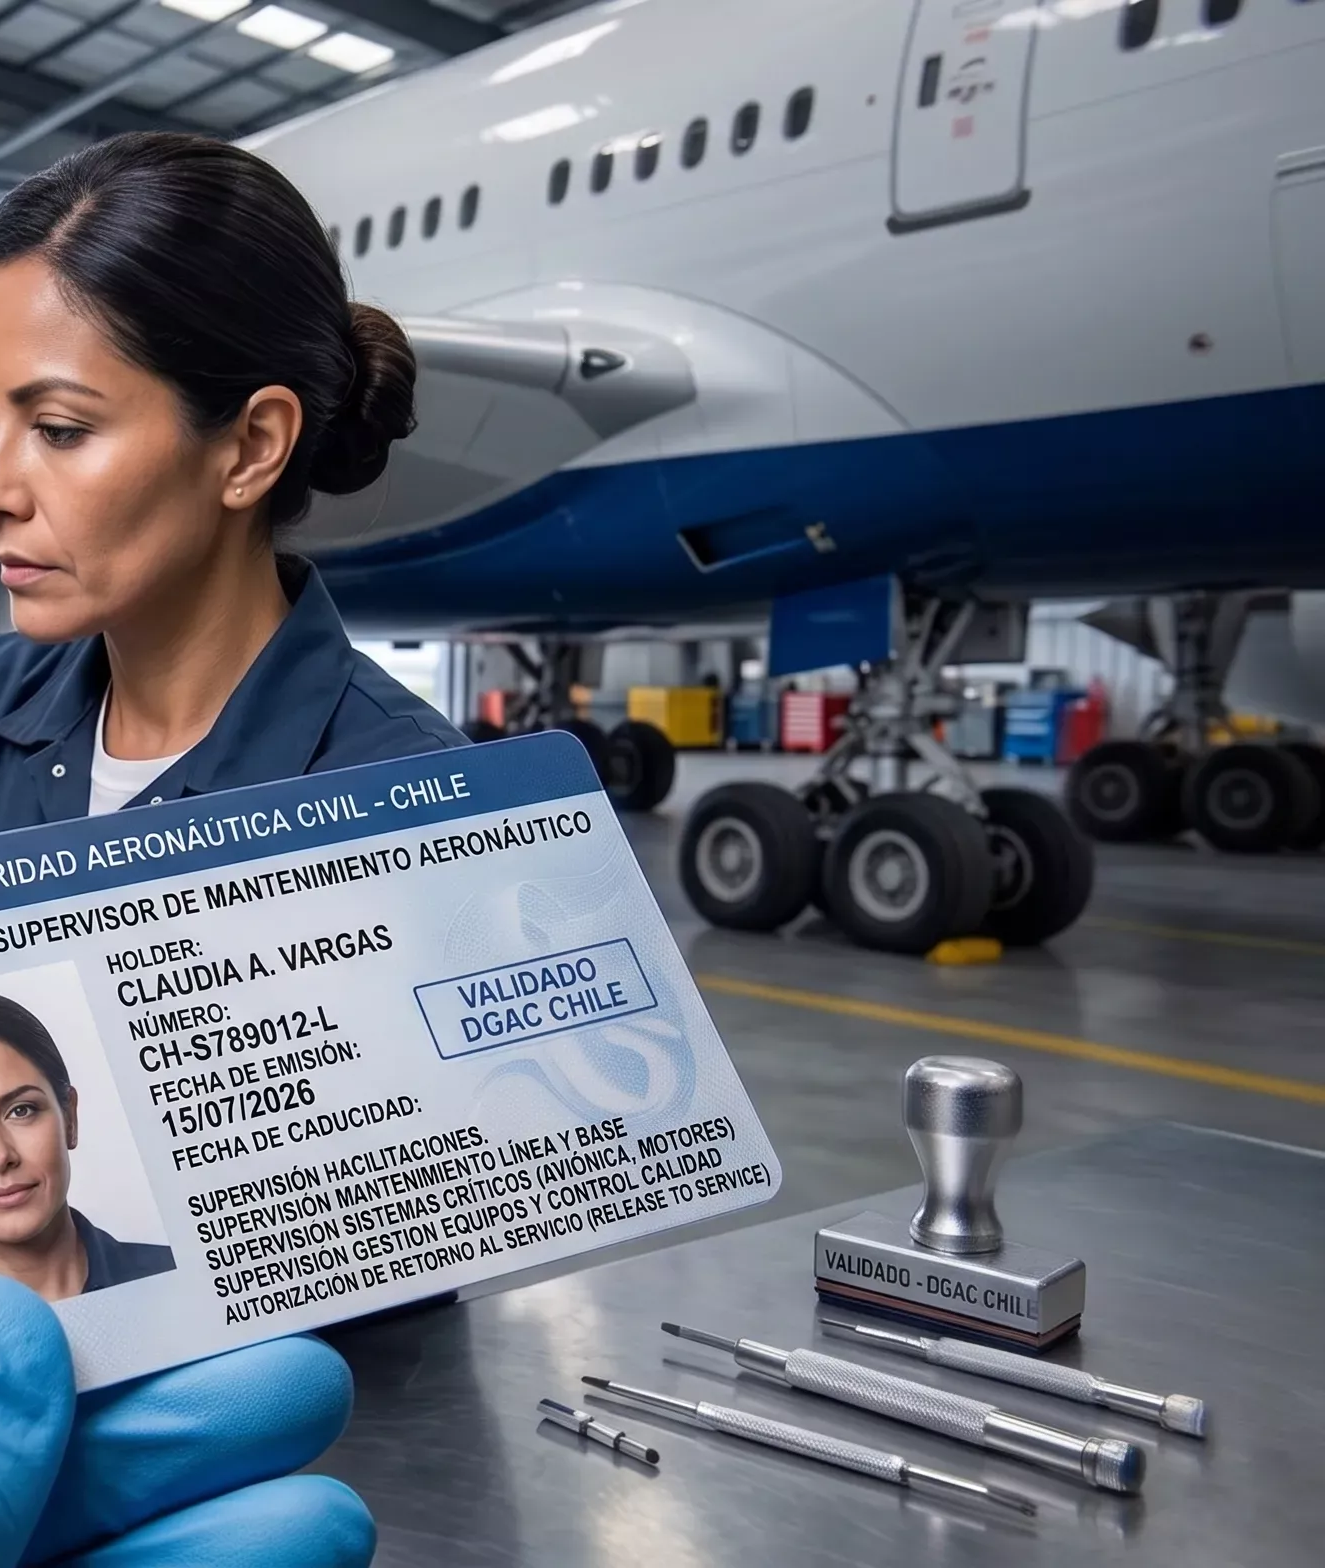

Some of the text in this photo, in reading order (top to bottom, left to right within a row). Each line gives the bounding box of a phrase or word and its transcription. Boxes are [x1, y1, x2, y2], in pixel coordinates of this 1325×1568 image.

[89, 809, 291, 870] AERONÁÚTICA
[297, 795, 368, 827] CIVIL
[391, 774, 470, 809] CHILE
[163, 890, 200, 918] DE
[204, 848, 411, 909] MANTENIMIENTO
[421, 811, 591, 866] AERONÁUTICO
[106, 939, 202, 974] HOLDER:
[118, 925, 392, 1006] CLAUDIA A. VARGAS
[457, 958, 596, 1008] VALIDADO
[129, 1004, 230, 1040] NÚMERO:
[140, 1006, 338, 1072] CH-S789012-L
[461, 981, 628, 1042] DGAC CHILE
[150, 1040, 360, 1105] FECHA DE EMISIÓN:
[162, 1079, 315, 1137] 15/07/2026
[172, 1096, 421, 1171] FECHA DE CADUCIDAD:
[188, 1127, 488, 1216] SUPERVISIÓN HACILITACIONES.
[197, 1117, 627, 1243] SUPERVISIÓN MANTENIMIENTO LÍNEA Y BASE
[206, 1116, 735, 1270] SUPERVISIÓN SISTEMAS CRÍTICOS (AVIÓNICA, MOTORES)
[214, 1148, 721, 1297] SUPERVISIÓN GESTION EQUIPOS Y CONTROL CALIDAD
[227, 1163, 770, 1325] AUTORIZACIÓN DE RETORNO AL SERVICIO (RELEASE TO SERVICE)
[825, 1249, 911, 1287] VALIDADO
[927, 1275, 978, 1304] DGAC
